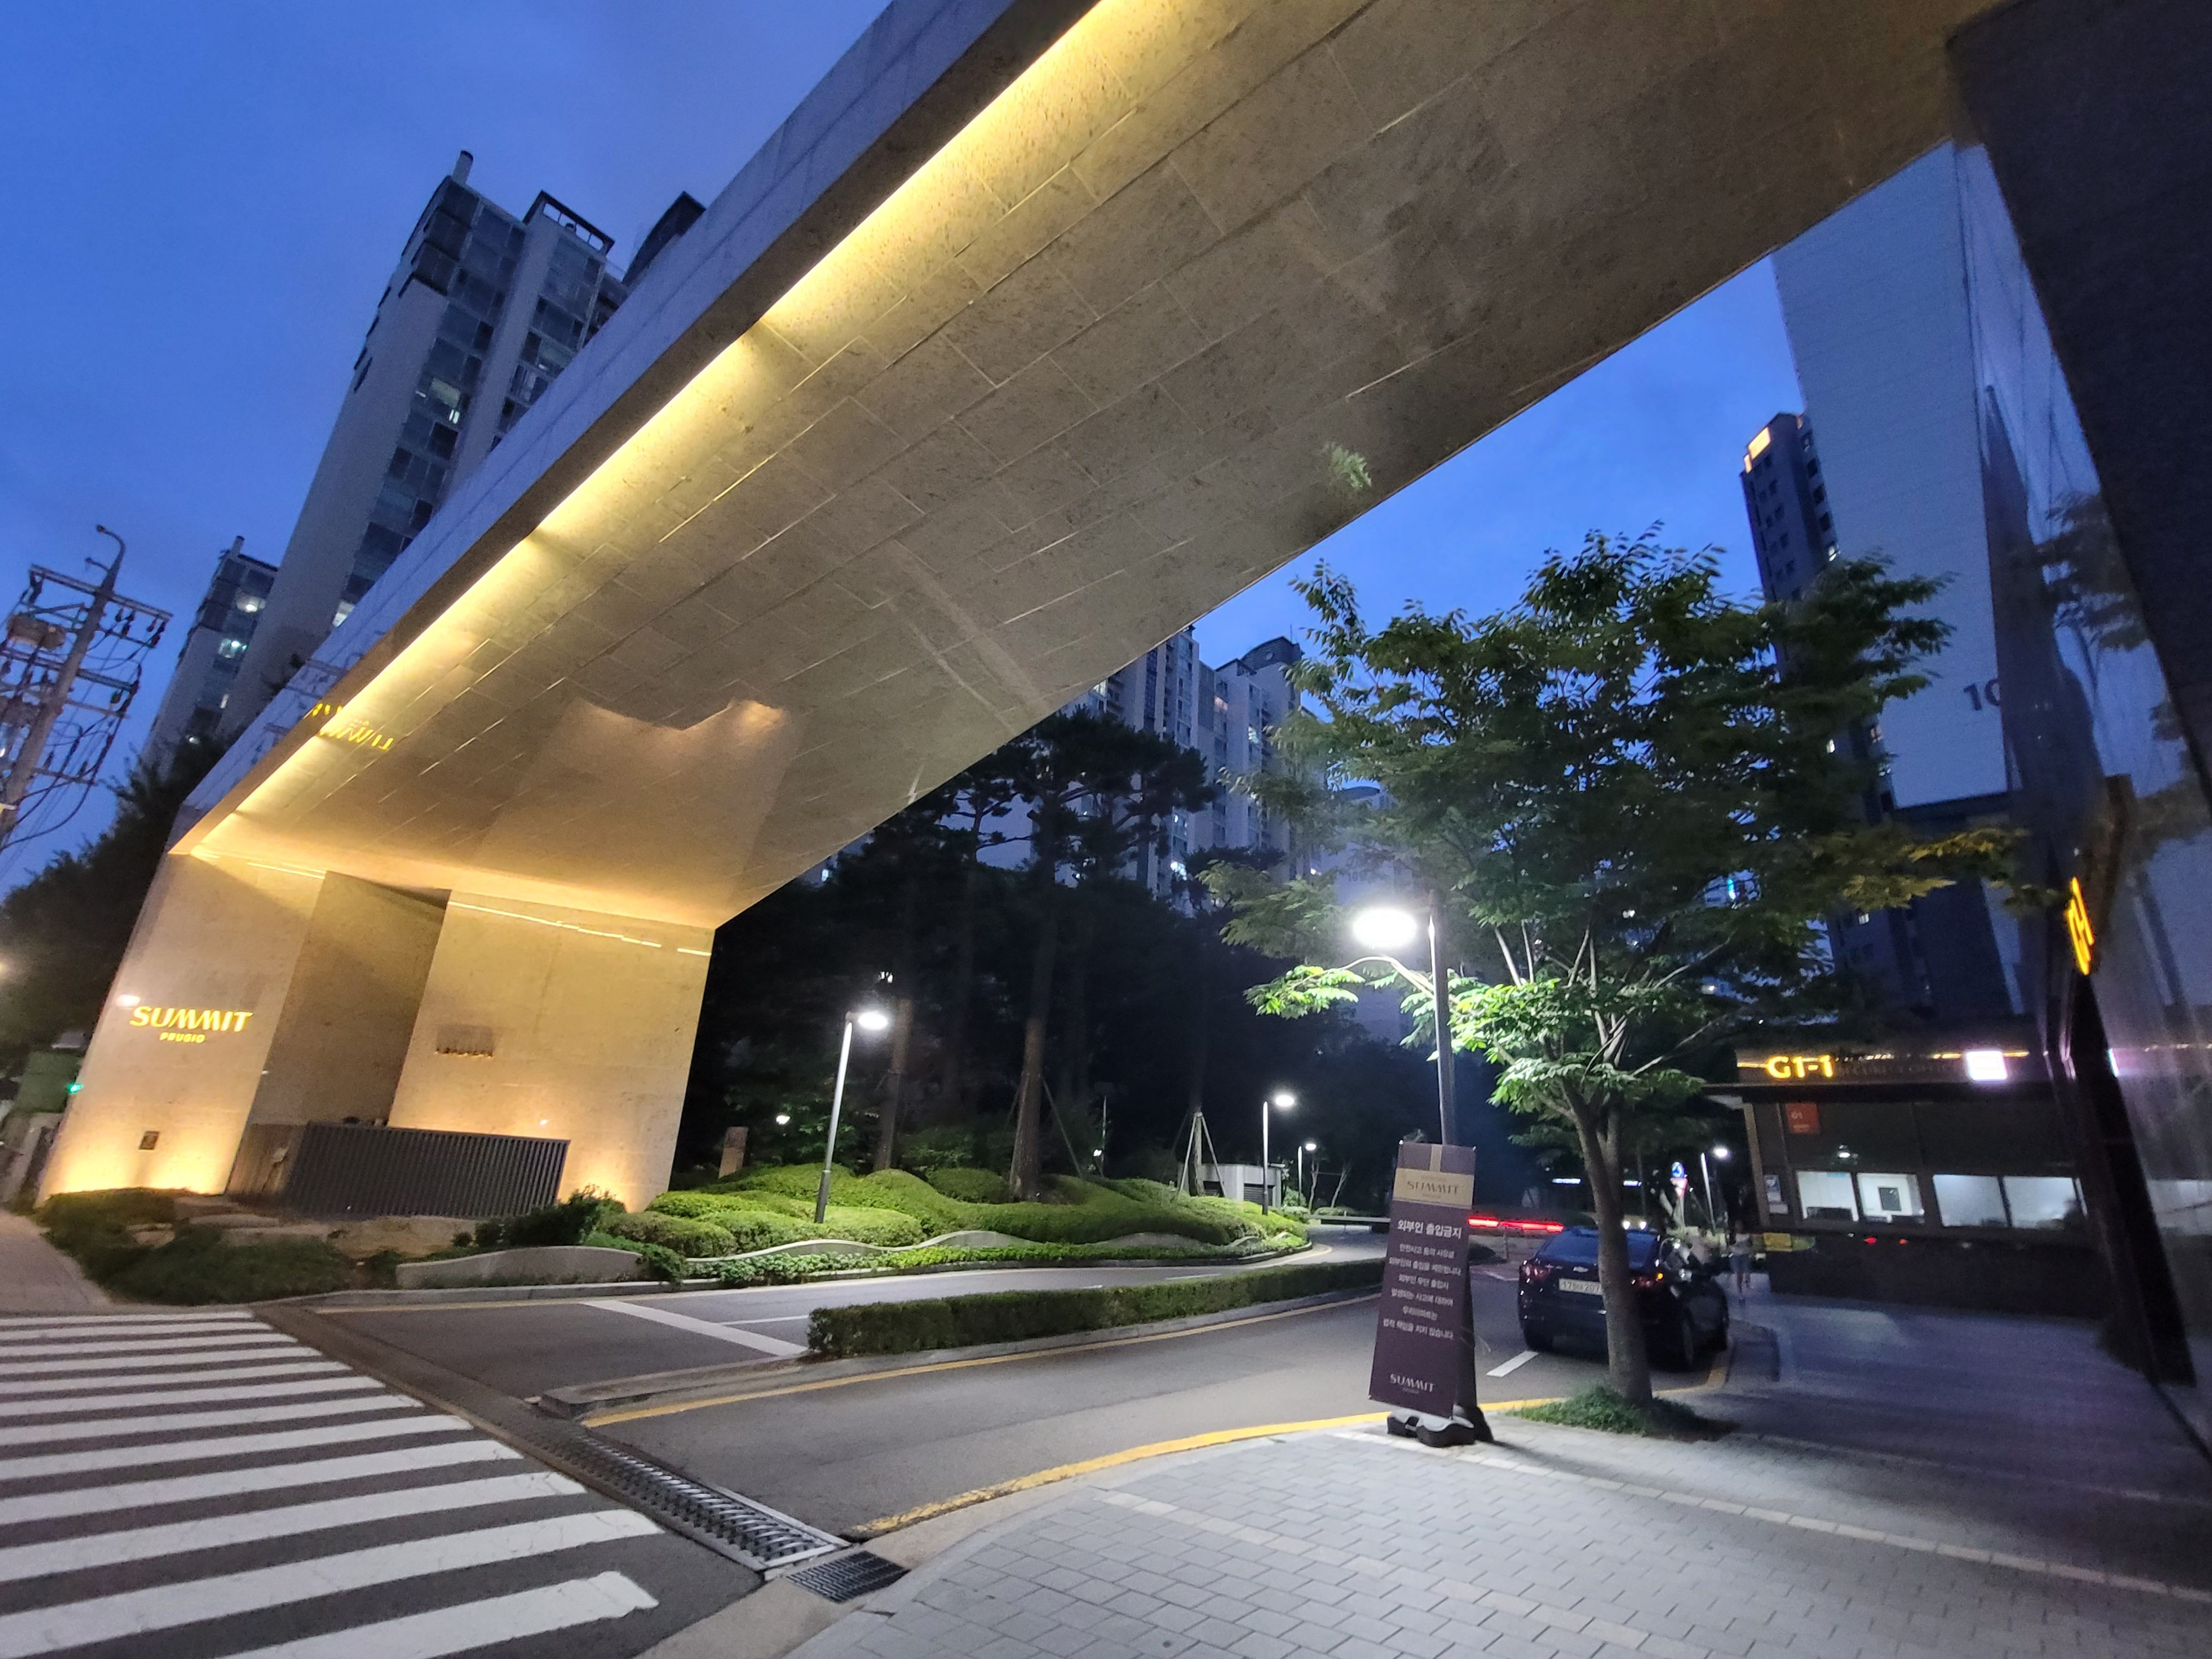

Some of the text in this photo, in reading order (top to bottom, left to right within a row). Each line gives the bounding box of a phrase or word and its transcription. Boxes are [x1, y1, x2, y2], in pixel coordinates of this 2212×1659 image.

[129, 1006, 253, 1032] SUMMIT
[159, 1031, 205, 1044] PRUGIO
[1407, 1181, 1459, 1194] SUMMIT
[1398, 1219, 1462, 1239] 외부인 출입금지
[1390, 1374, 1434, 1392] SUMMIT
